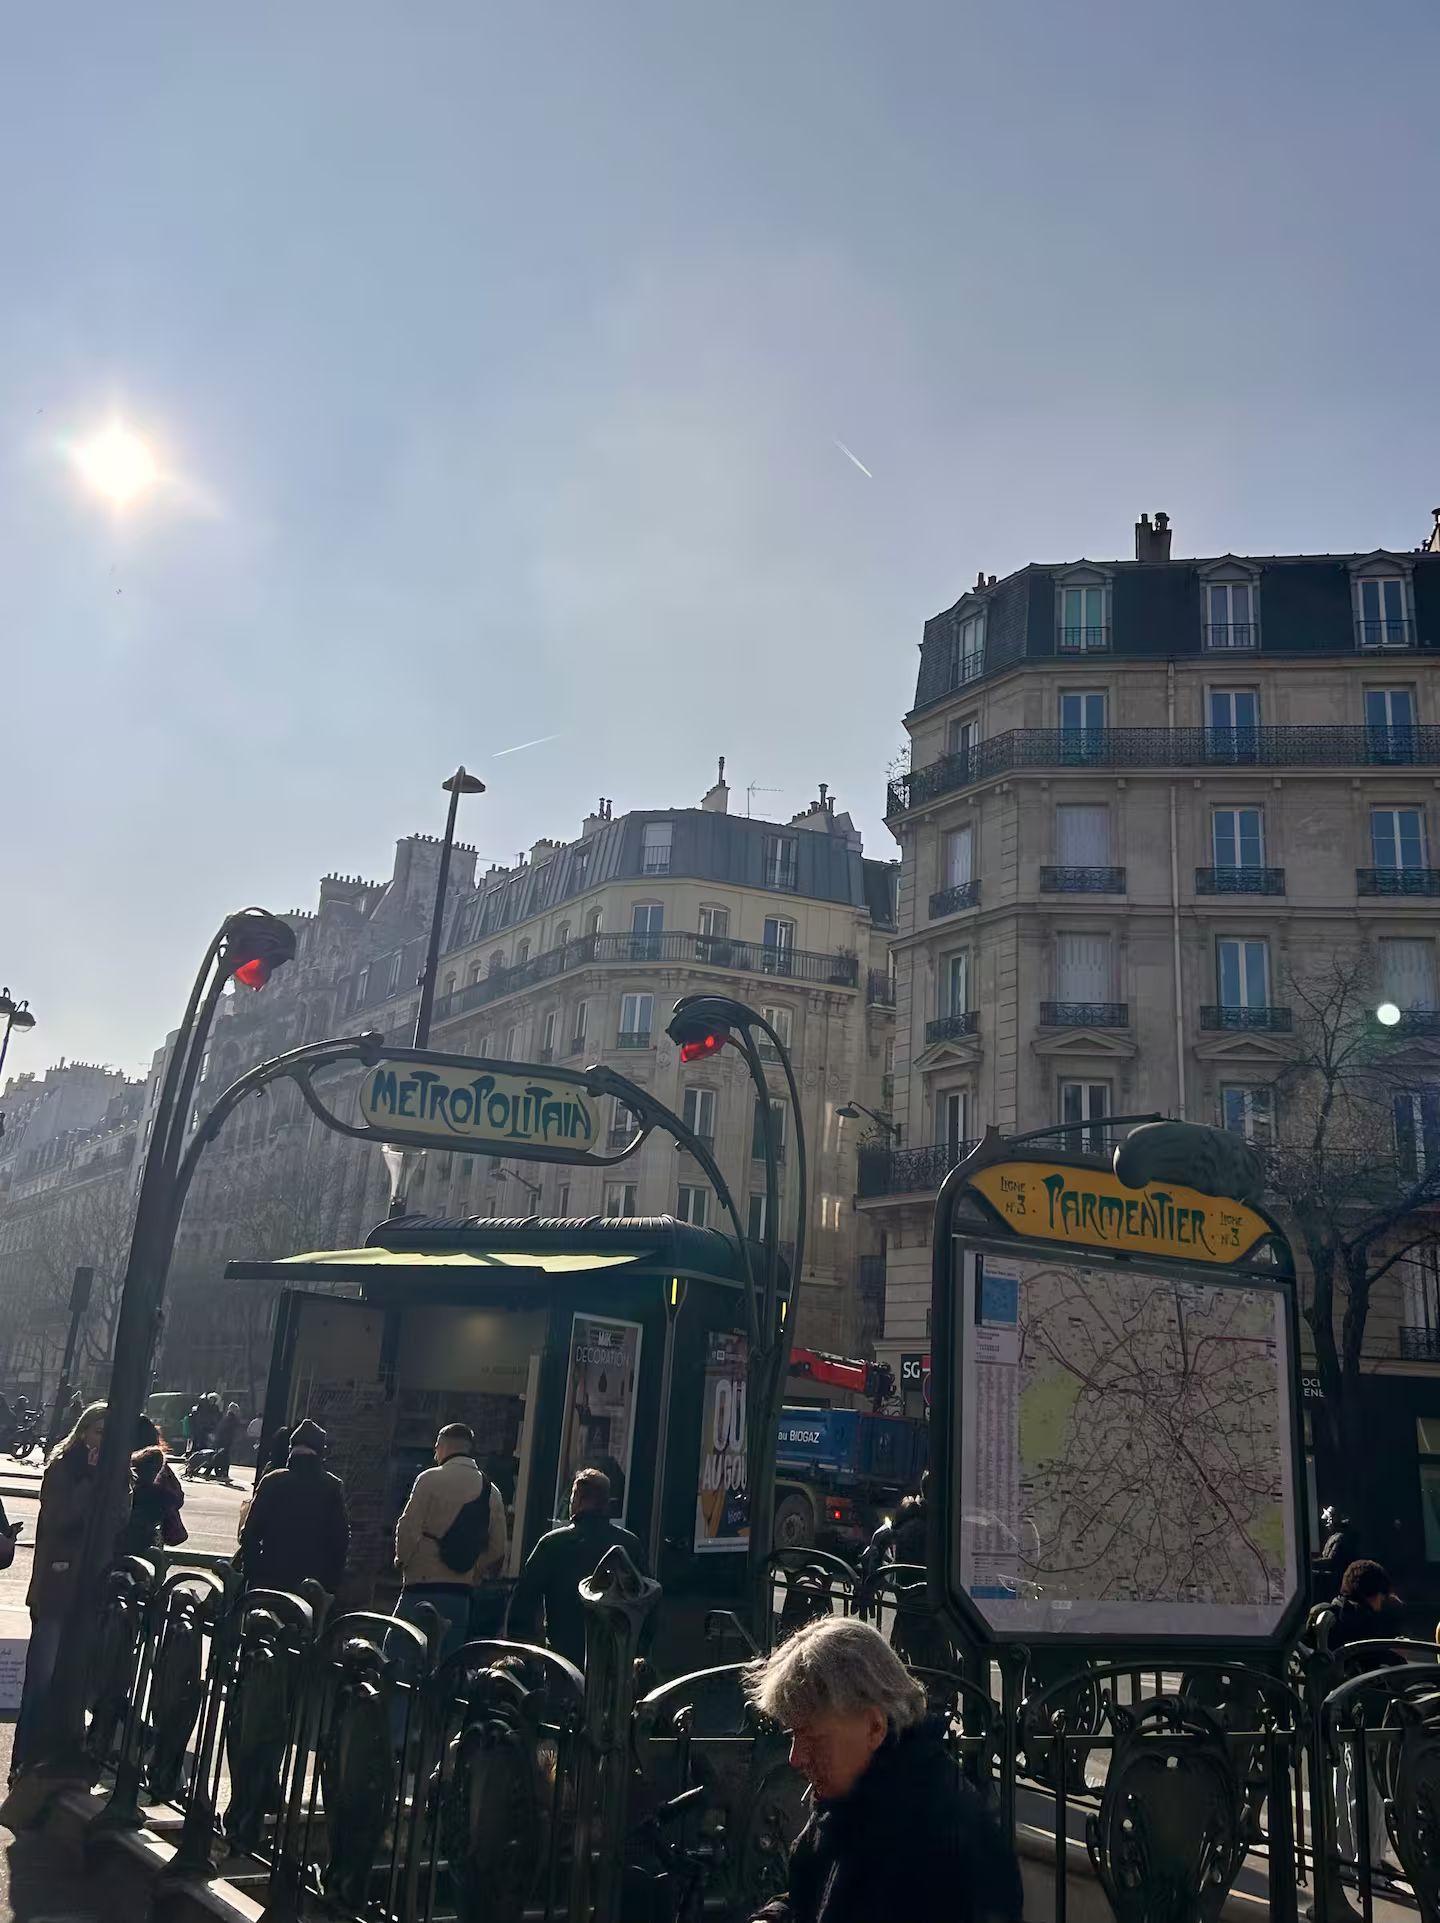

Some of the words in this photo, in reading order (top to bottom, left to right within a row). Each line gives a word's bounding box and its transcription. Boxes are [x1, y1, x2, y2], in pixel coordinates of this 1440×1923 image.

[370, 1070, 591, 1141] METROPOLITAIN
[1041, 1173, 1216, 1255] PARMENTIER
[903, 1361, 920, 1379] SG
[789, 1429, 820, 1444] BIOGAZ
[703, 1454, 722, 1490] AU
